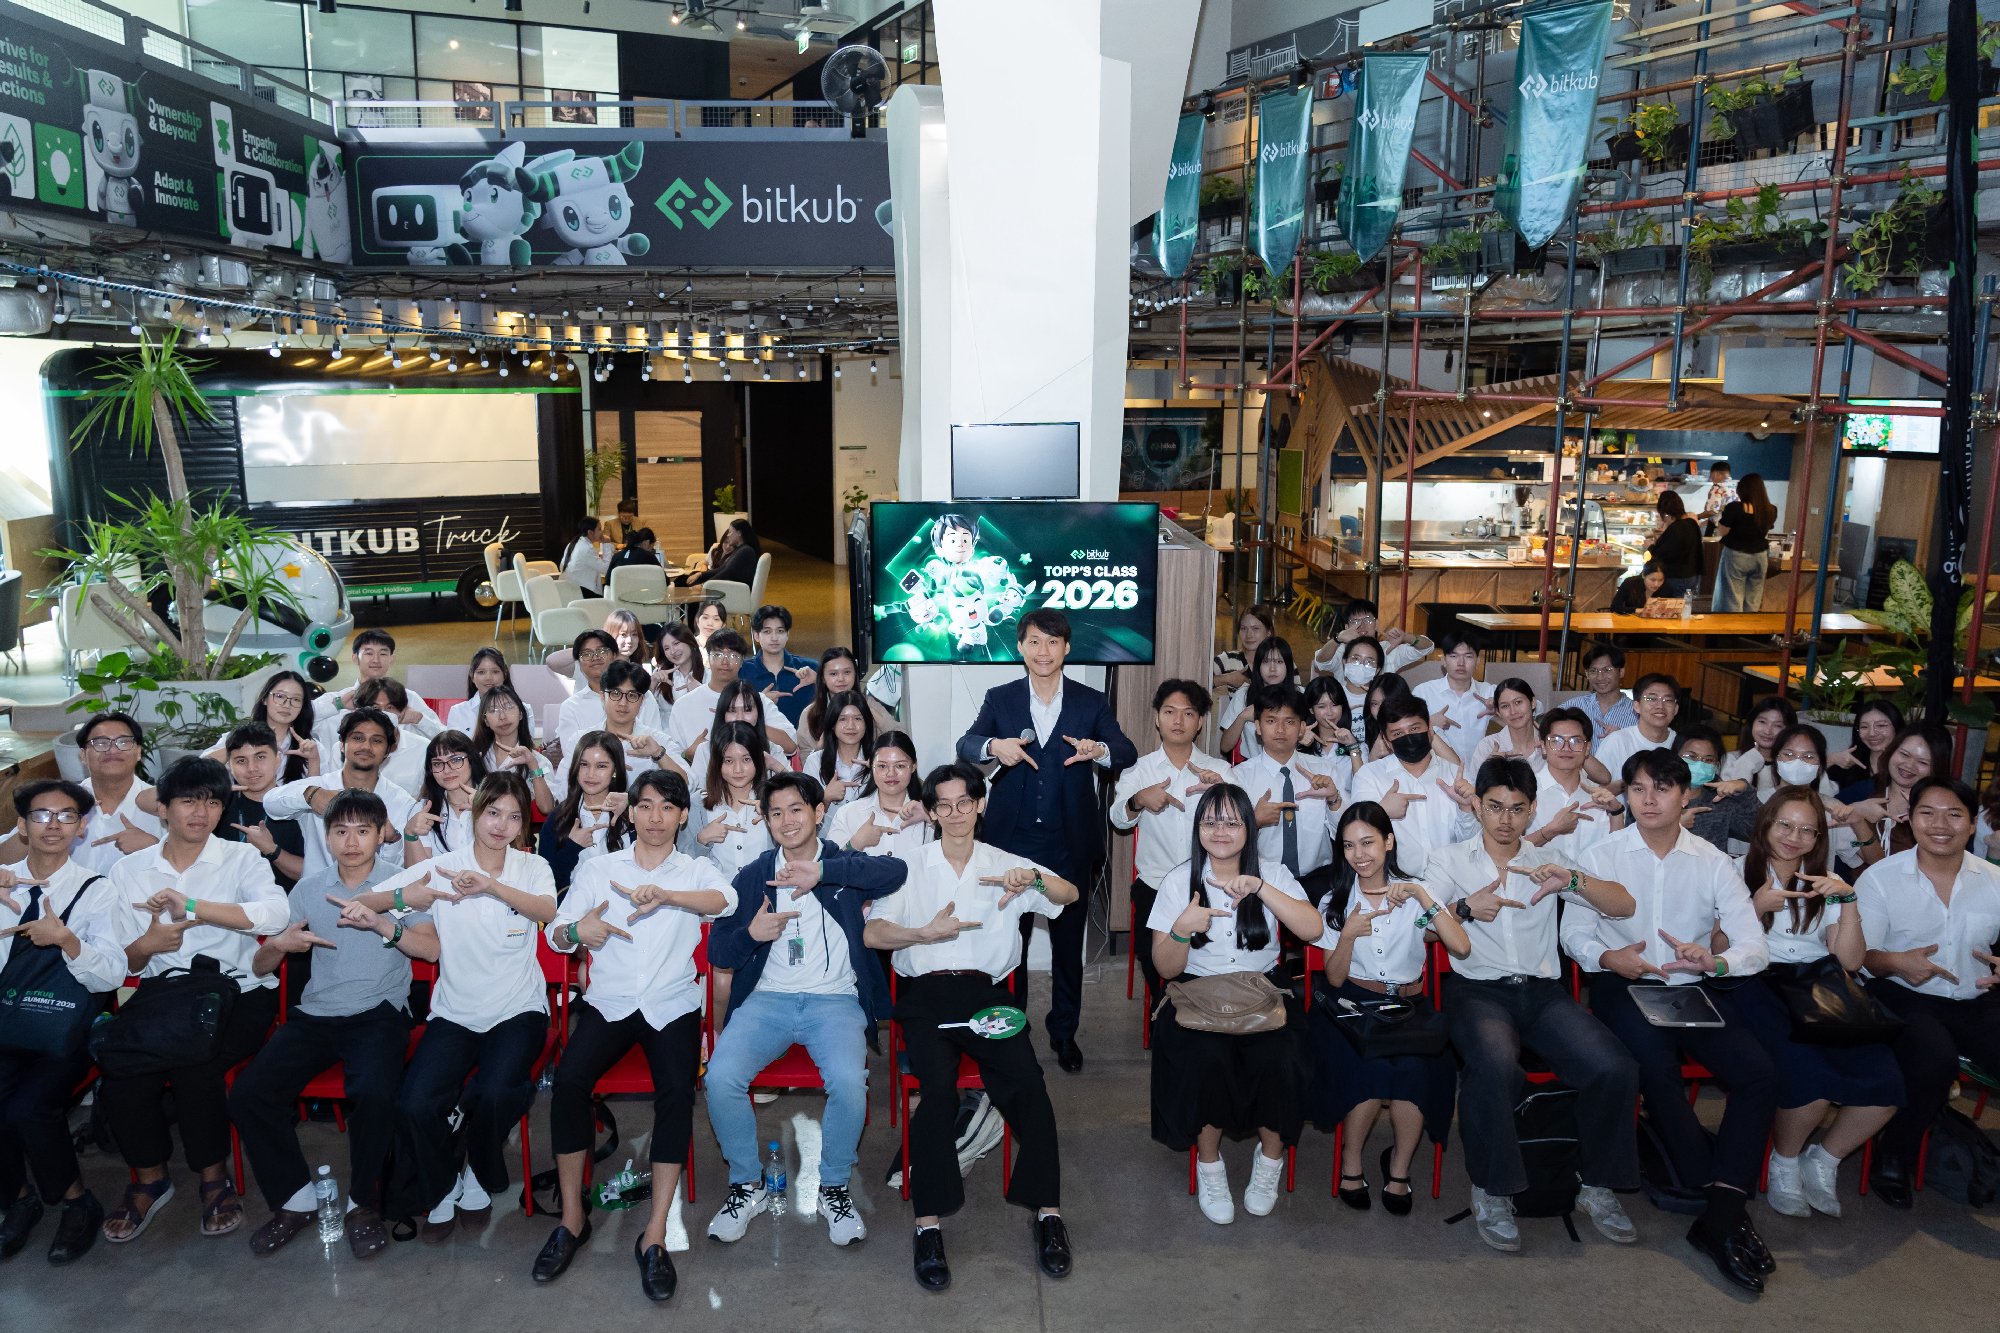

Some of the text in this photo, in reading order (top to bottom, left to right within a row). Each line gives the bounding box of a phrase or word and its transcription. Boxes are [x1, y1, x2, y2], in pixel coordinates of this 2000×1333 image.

[0, 37, 49, 68] rive for
[0, 60, 53, 89] esults &
[1550, 69, 1599, 94] bitkub
[0, 80, 46, 106] ctions
[148, 97, 203, 131] Ownership
[149, 115, 198, 144] & Beyond
[242, 128, 278, 153] Empathy
[244, 144, 304, 176] & Collaboration
[1279, 139, 1309, 158] bitkub
[1177, 158, 1202, 177] bitkub
[154, 170, 195, 195] Adapt &
[155, 188, 200, 212] Innovate
[742, 184, 857, 224] bitkub
[301, 514, 521, 557] ITKUB Truck
[1086, 549, 1110, 558] bitkub
[1043, 565, 1138, 577] TOPP'S CLASS
[346, 588, 361, 596] pital
[384, 585, 413, 593] Holdings
[1041, 579, 1139, 610] 2026
[22, 996, 56, 1006] SUMMIT
